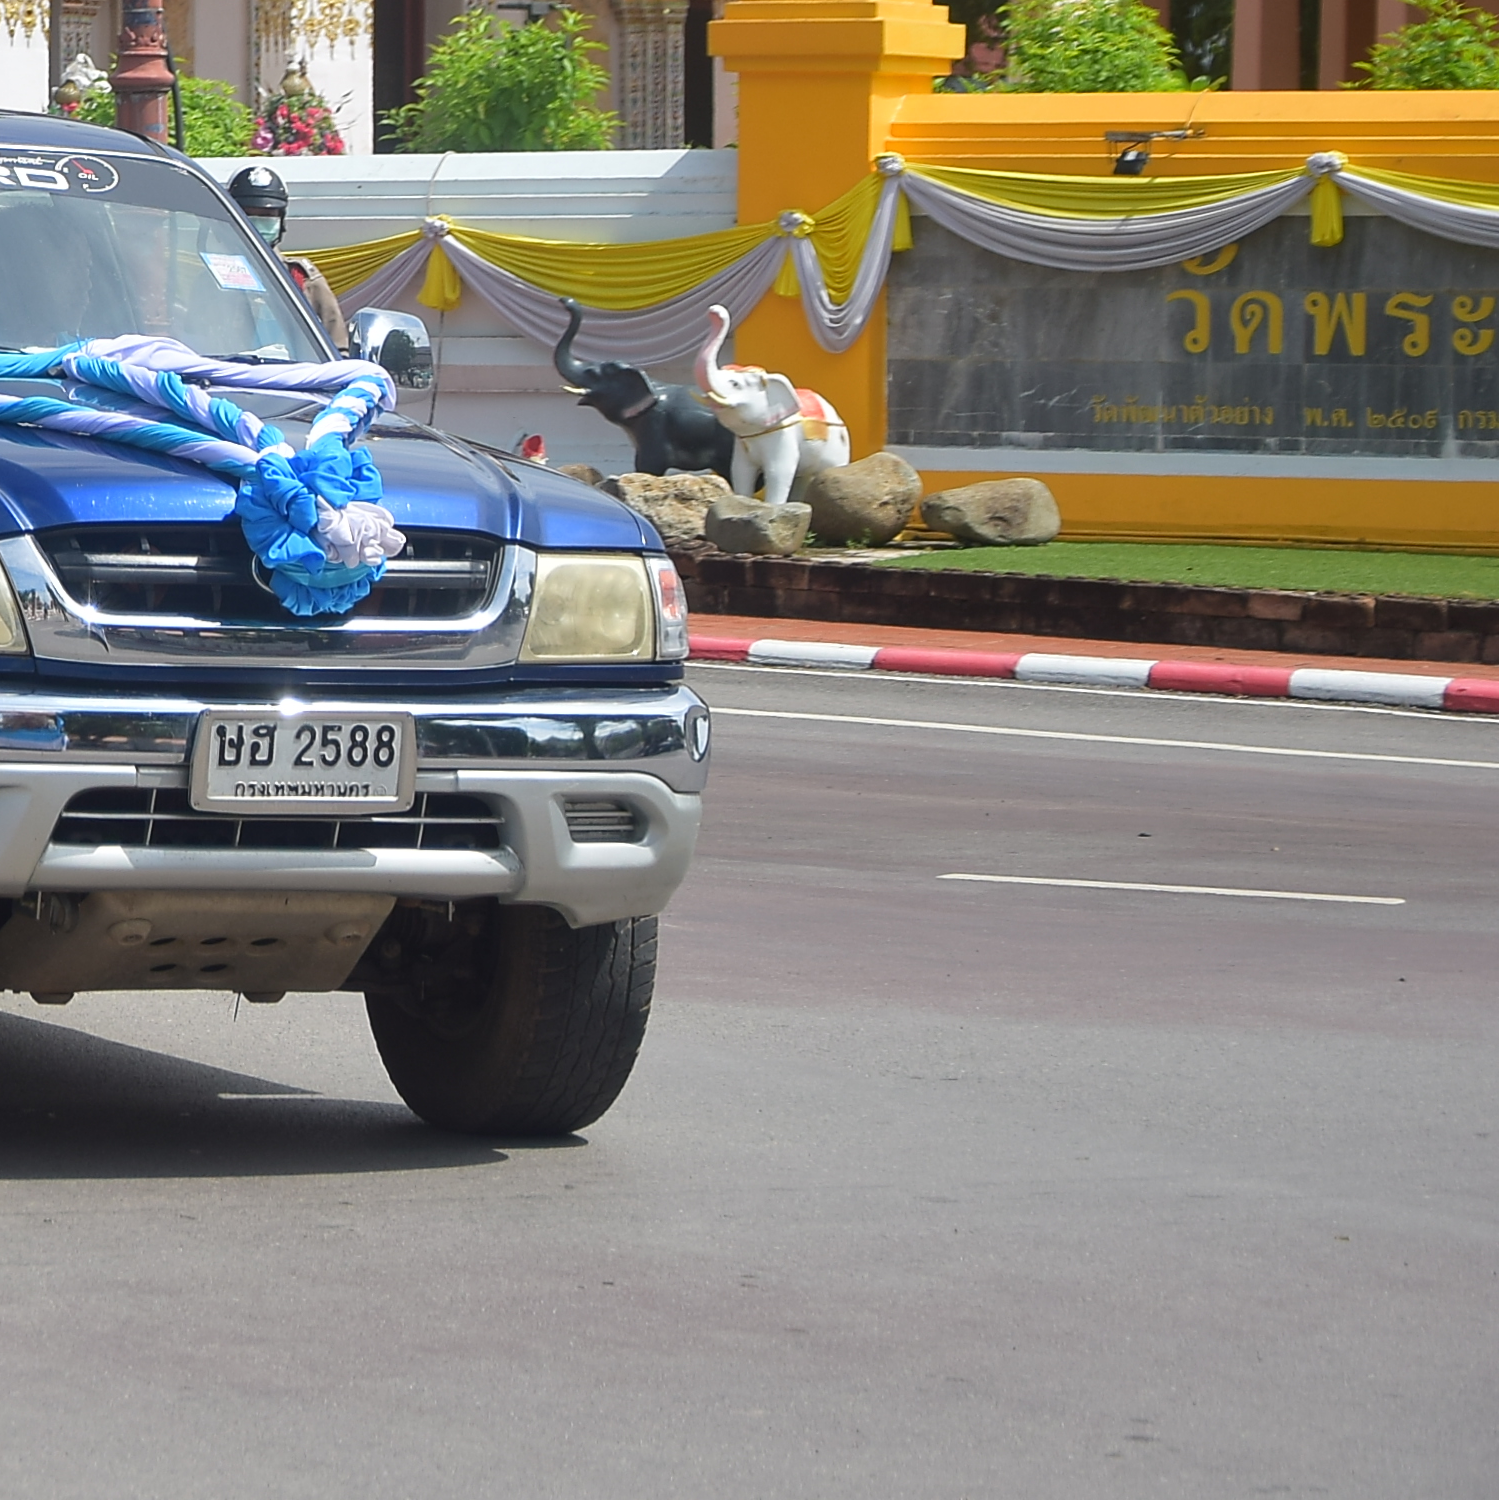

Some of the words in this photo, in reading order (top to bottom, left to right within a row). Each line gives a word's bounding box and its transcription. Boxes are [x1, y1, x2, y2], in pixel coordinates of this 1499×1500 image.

[77, 172, 99, 181] OIL
[216, 722, 278, 767] ษฮ
[292, 724, 397, 768] 2588
[234, 780, 372, 798] กรงเทพมหานคร
